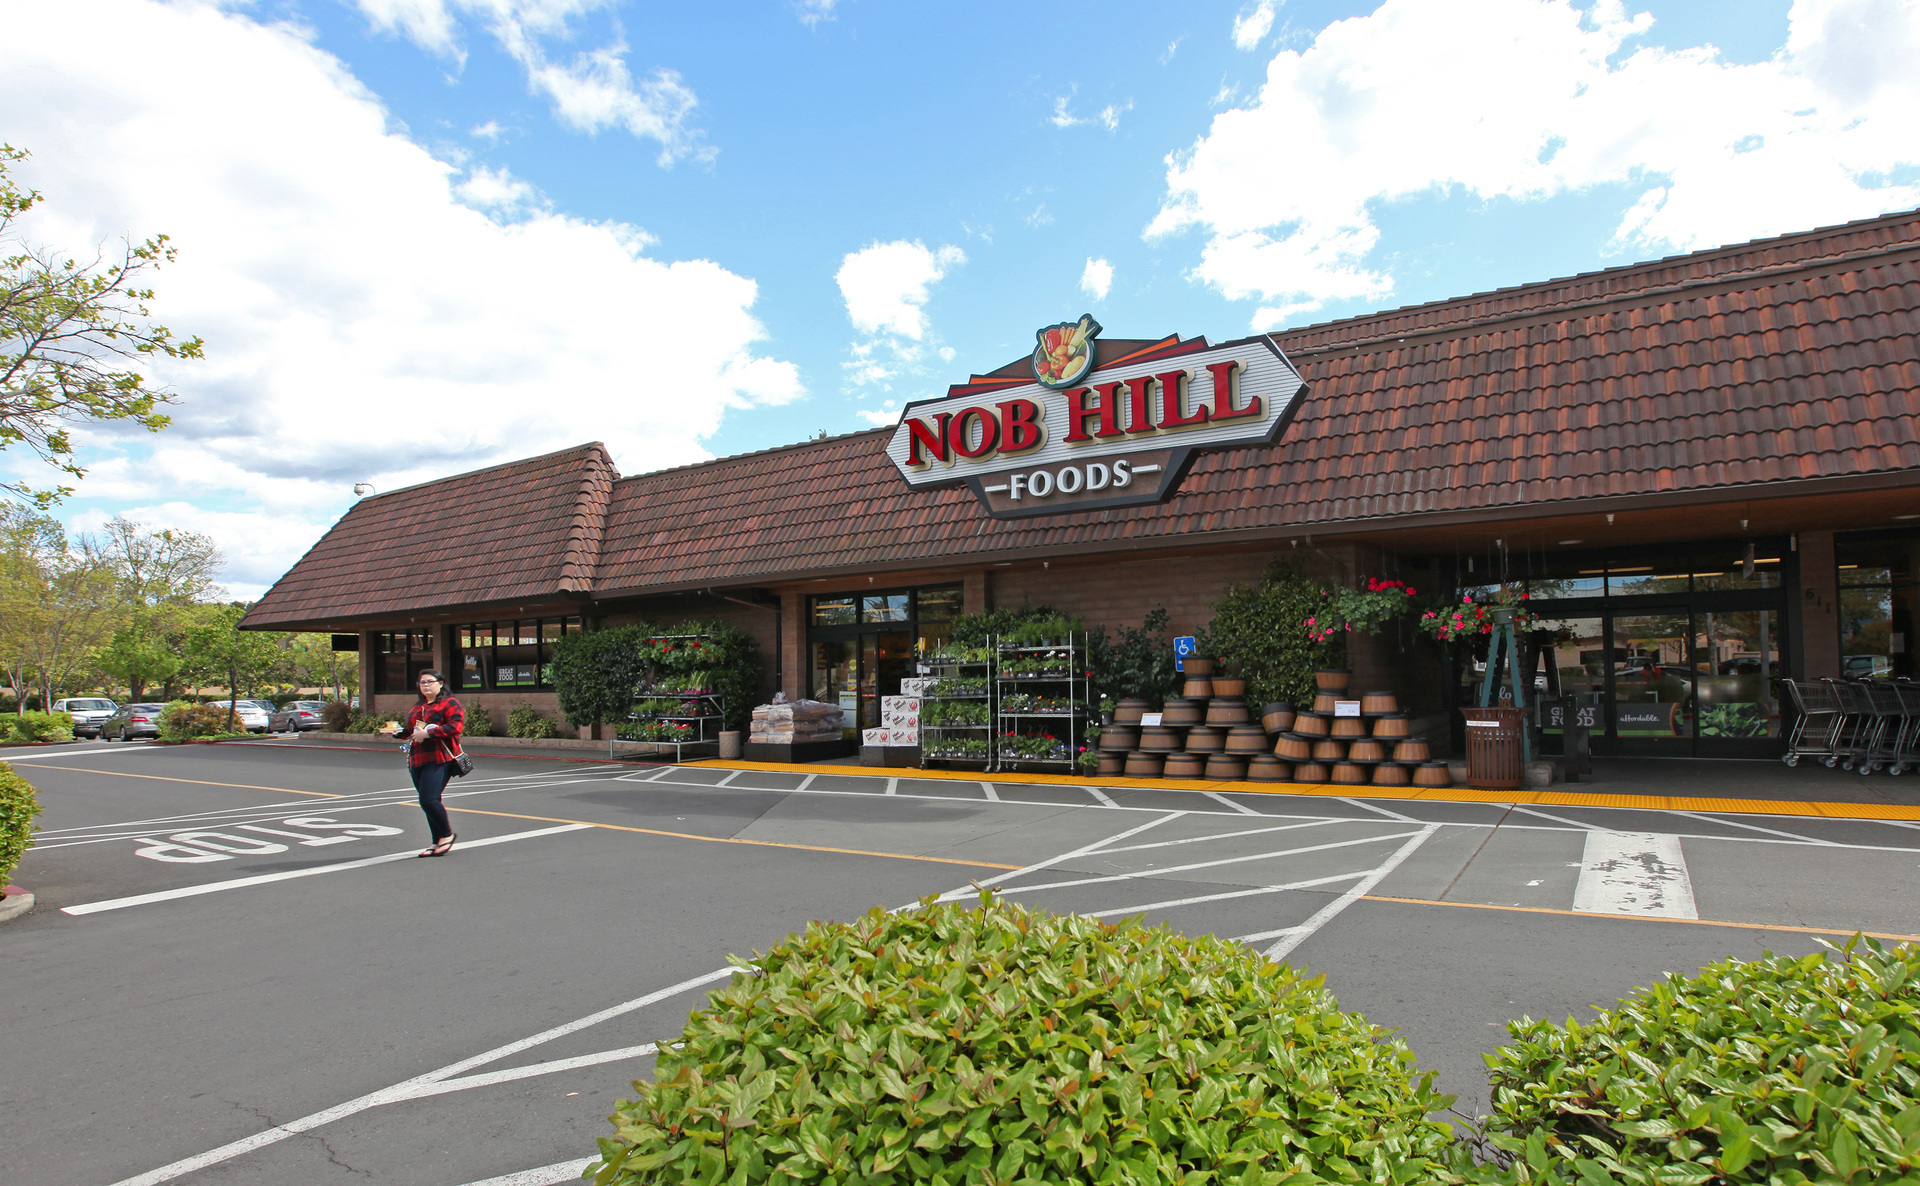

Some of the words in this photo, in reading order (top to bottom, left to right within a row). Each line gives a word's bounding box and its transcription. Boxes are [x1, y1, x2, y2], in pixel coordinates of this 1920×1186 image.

[903, 397, 1046, 468] NOB
[1062, 360, 1267, 442] HILL
[1010, 458, 1132, 500] FOODS
[1550, 706, 1596, 717] GAT
[1620, 713, 1660, 723] affordable.
[134, 817, 404, 864] STOP
